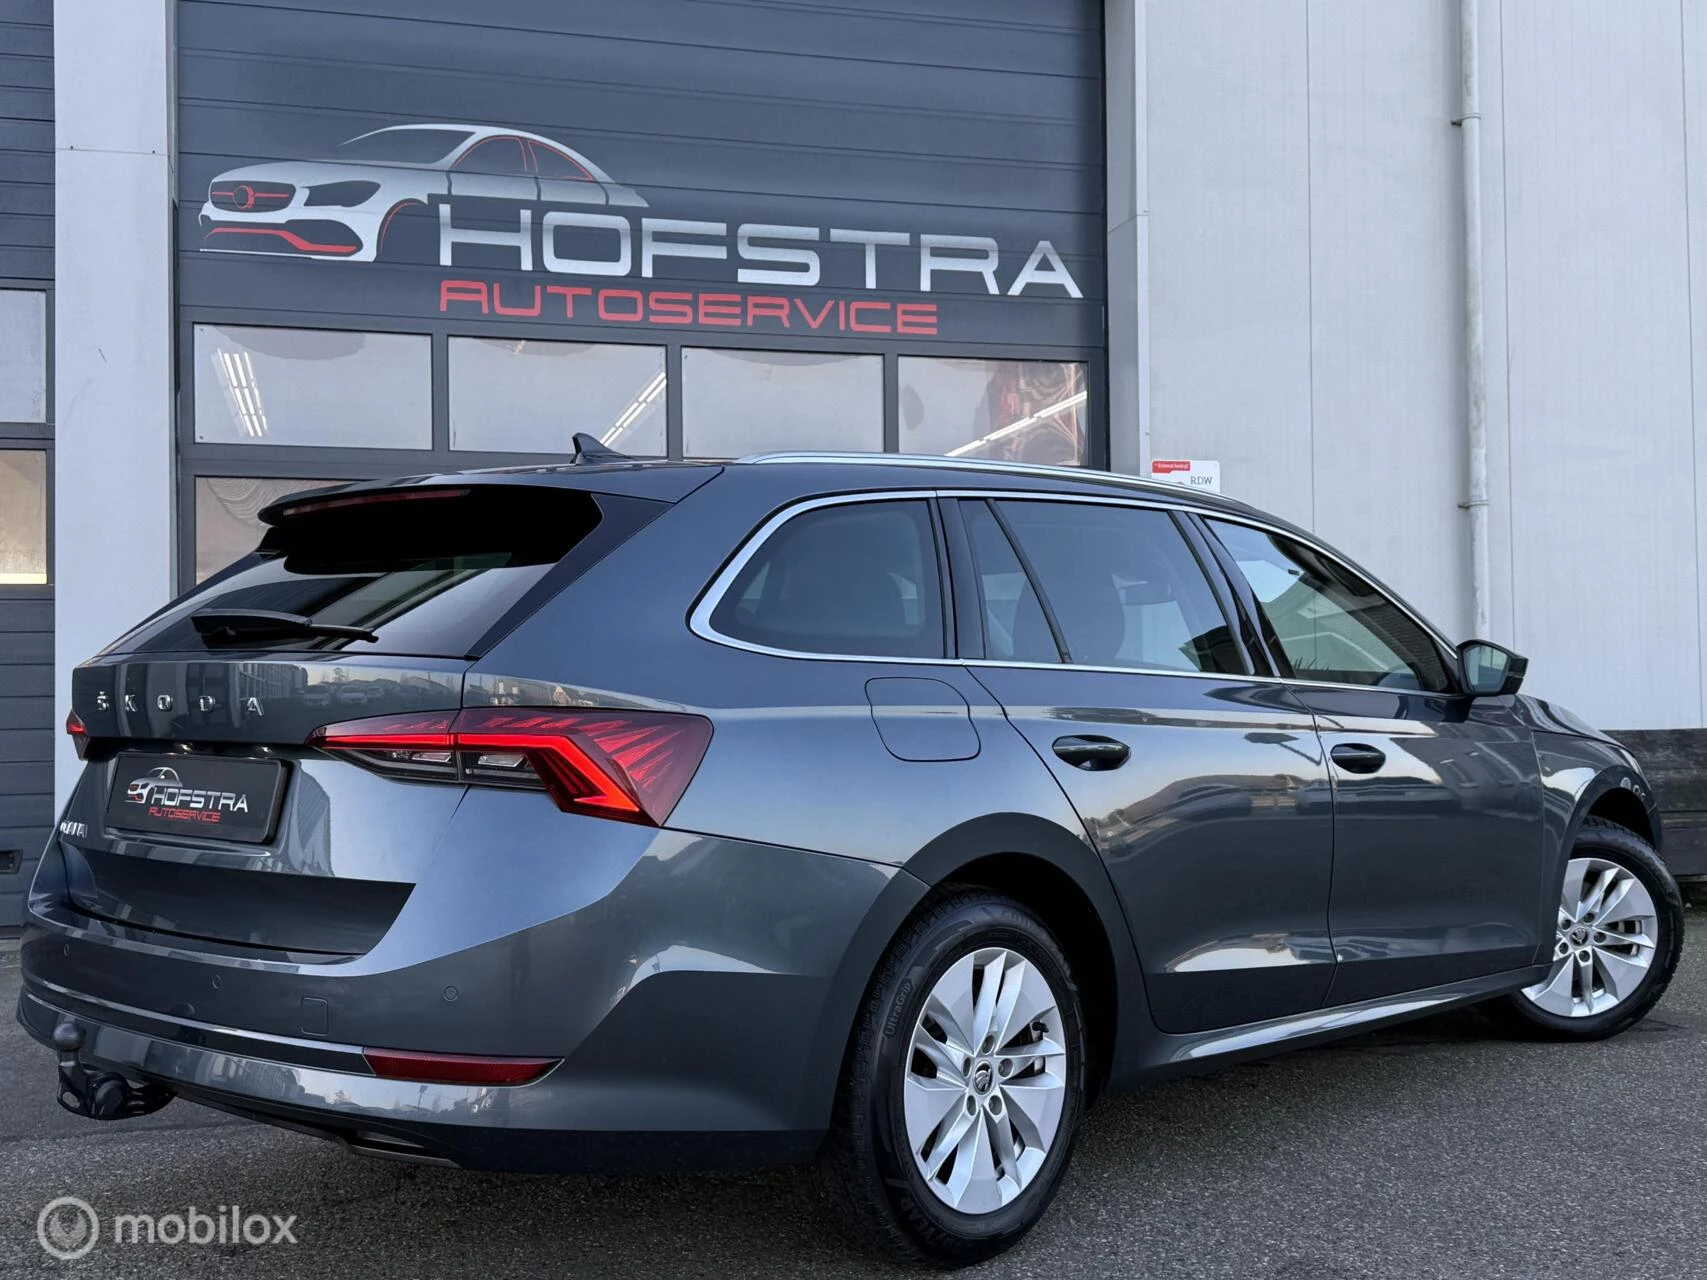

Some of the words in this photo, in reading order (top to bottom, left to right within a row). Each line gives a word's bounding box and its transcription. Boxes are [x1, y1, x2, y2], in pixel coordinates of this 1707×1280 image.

[439, 203, 1084, 299] HOFSTRA
[439, 279, 938, 336] AUTOSERVICE
[1190, 475, 1213, 485] RDW
[97, 690, 265, 716] ŠKODA
[150, 786, 249, 813] HOFSTRA
[148, 806, 222, 823] AUTOSERVICE
[884, 982, 912, 1036] UltraGrip
